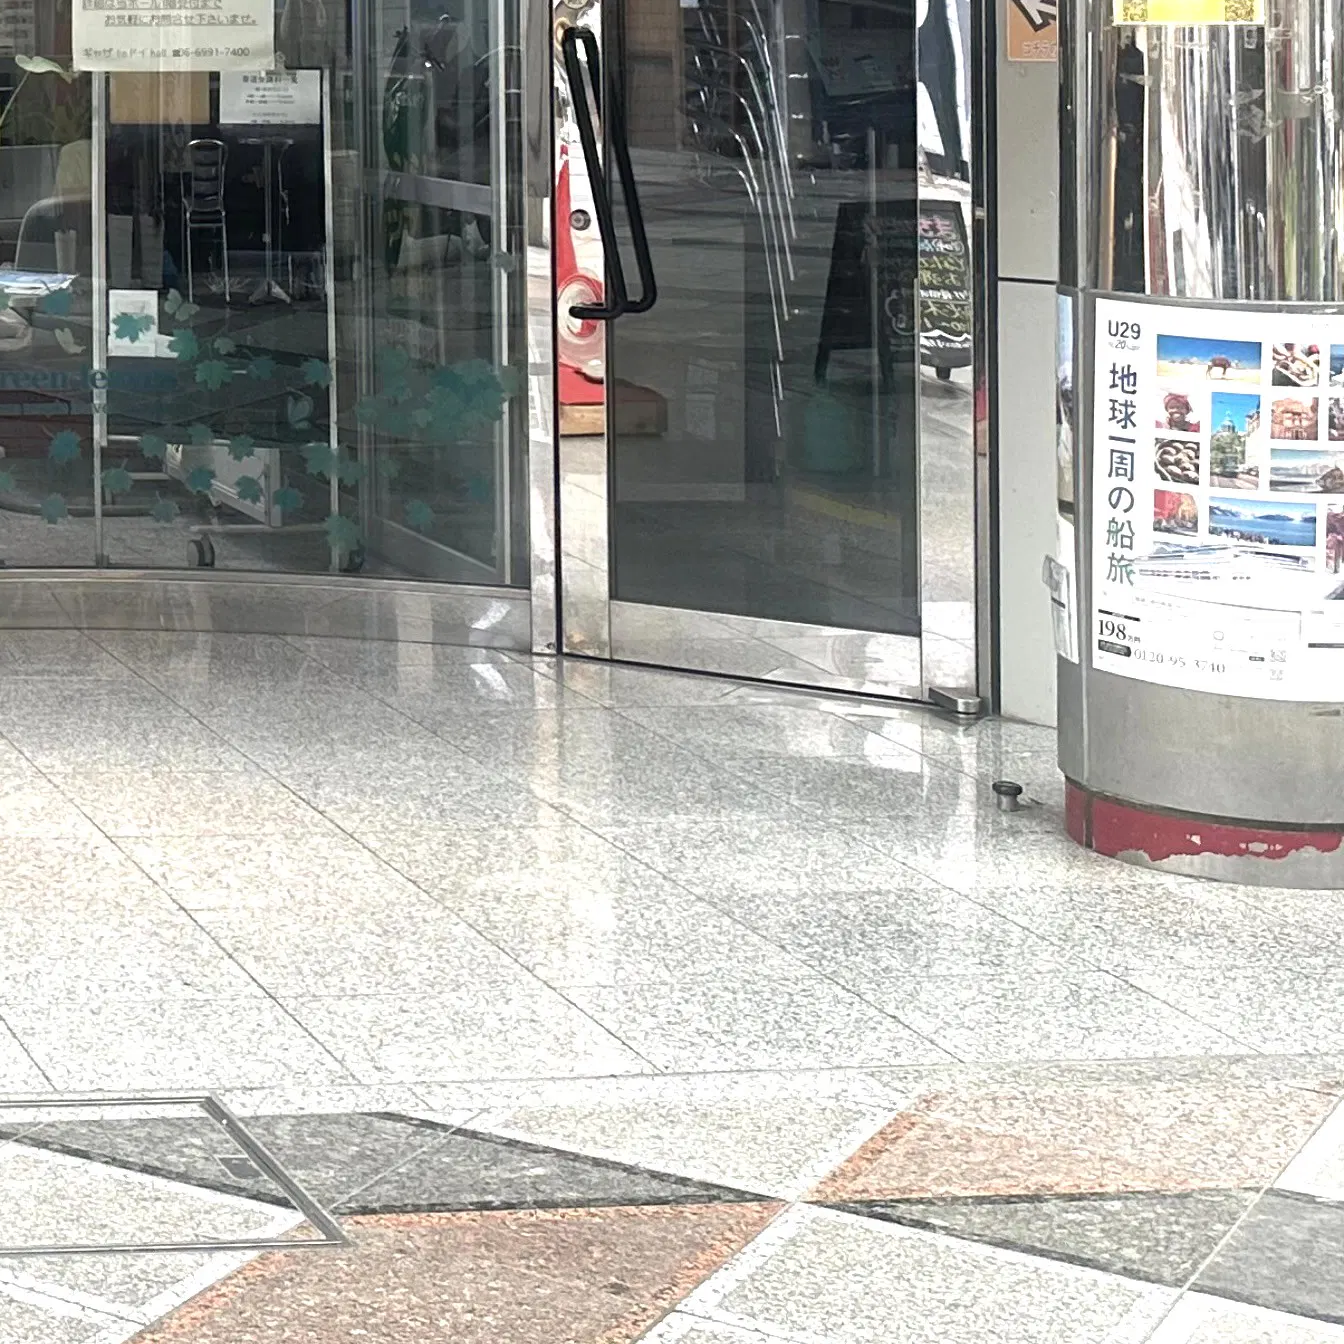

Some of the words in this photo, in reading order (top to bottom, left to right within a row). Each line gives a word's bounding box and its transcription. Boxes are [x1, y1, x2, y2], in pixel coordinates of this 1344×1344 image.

[1108, 319, 1141, 340] U29
[1106, 362, 1138, 587] 地球一周の船旅
